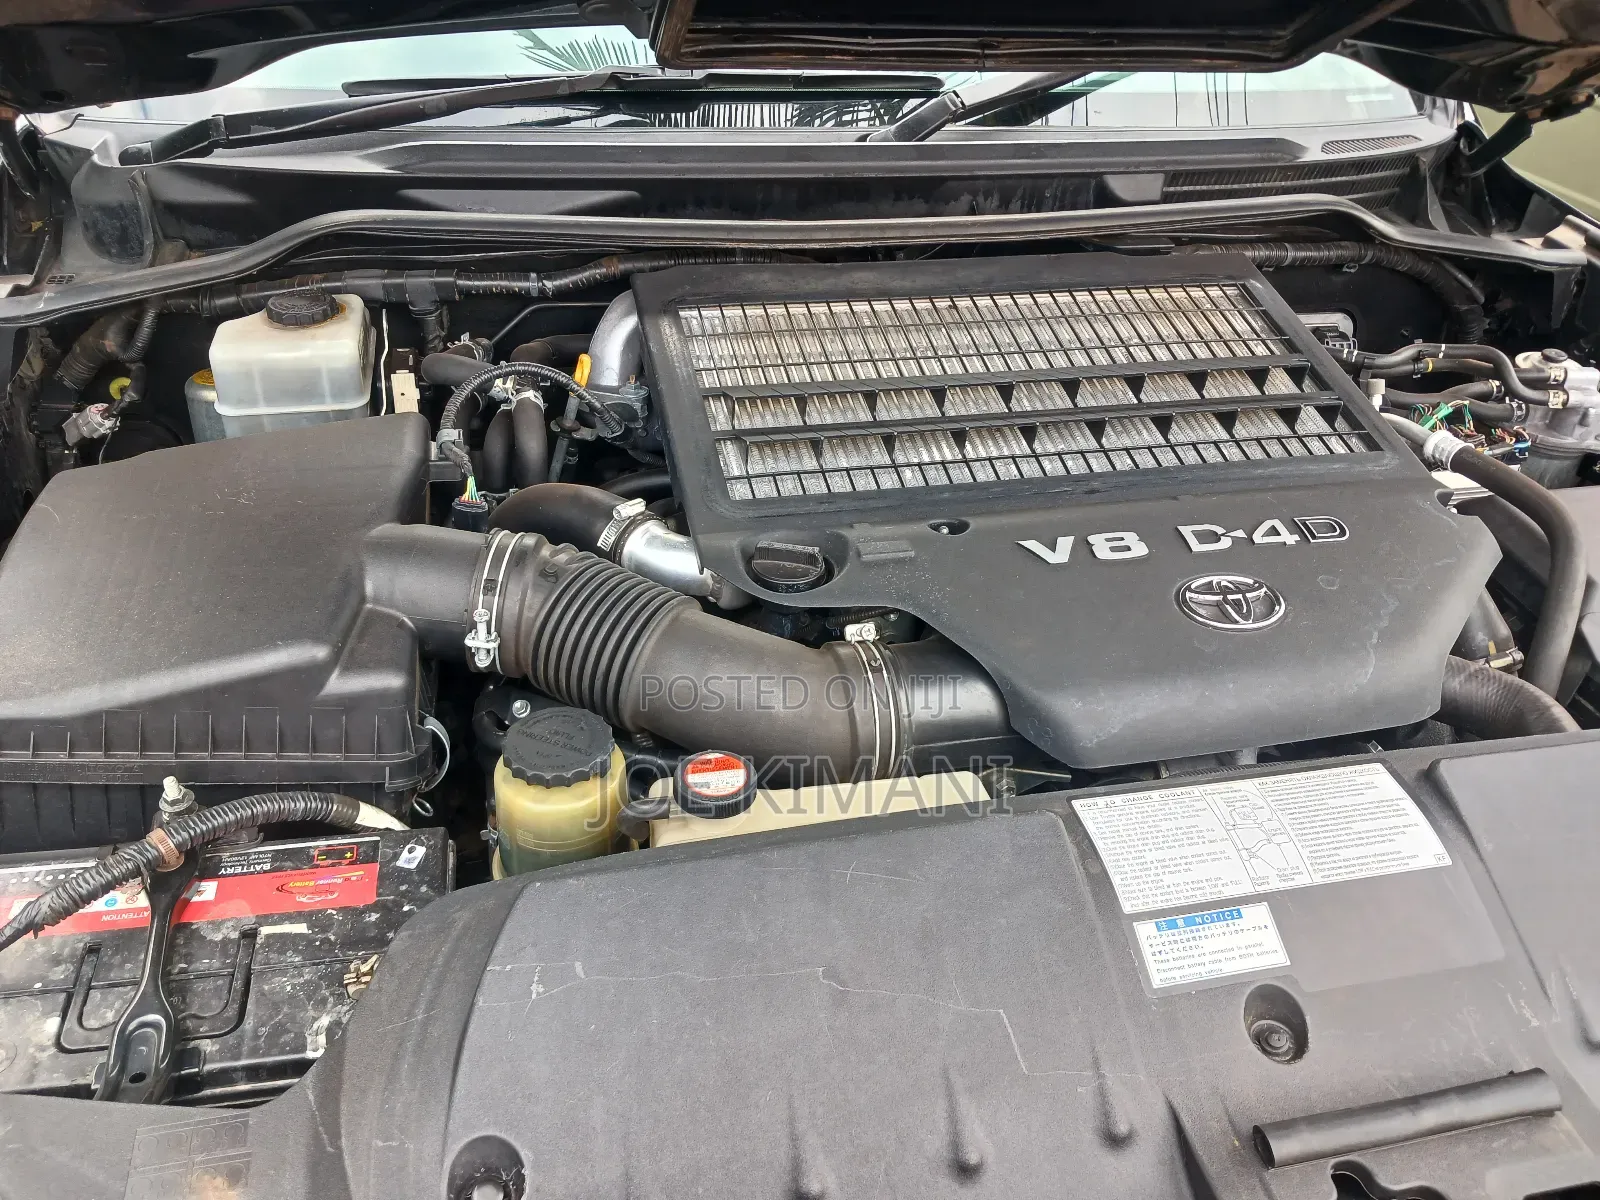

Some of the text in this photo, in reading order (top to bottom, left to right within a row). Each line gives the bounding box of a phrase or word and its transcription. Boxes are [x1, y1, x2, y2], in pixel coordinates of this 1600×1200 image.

[1015, 515, 1351, 565] V8 D-4D
[1121, 795, 1153, 803] CHANGE
[1159, 790, 1196, 799] COOLANT
[218, 863, 270, 874] BATTERY
[288, 880, 314, 888] Battery
[102, 910, 150, 921] ATTENTION
[1194, 910, 1239, 924] NOTICE
